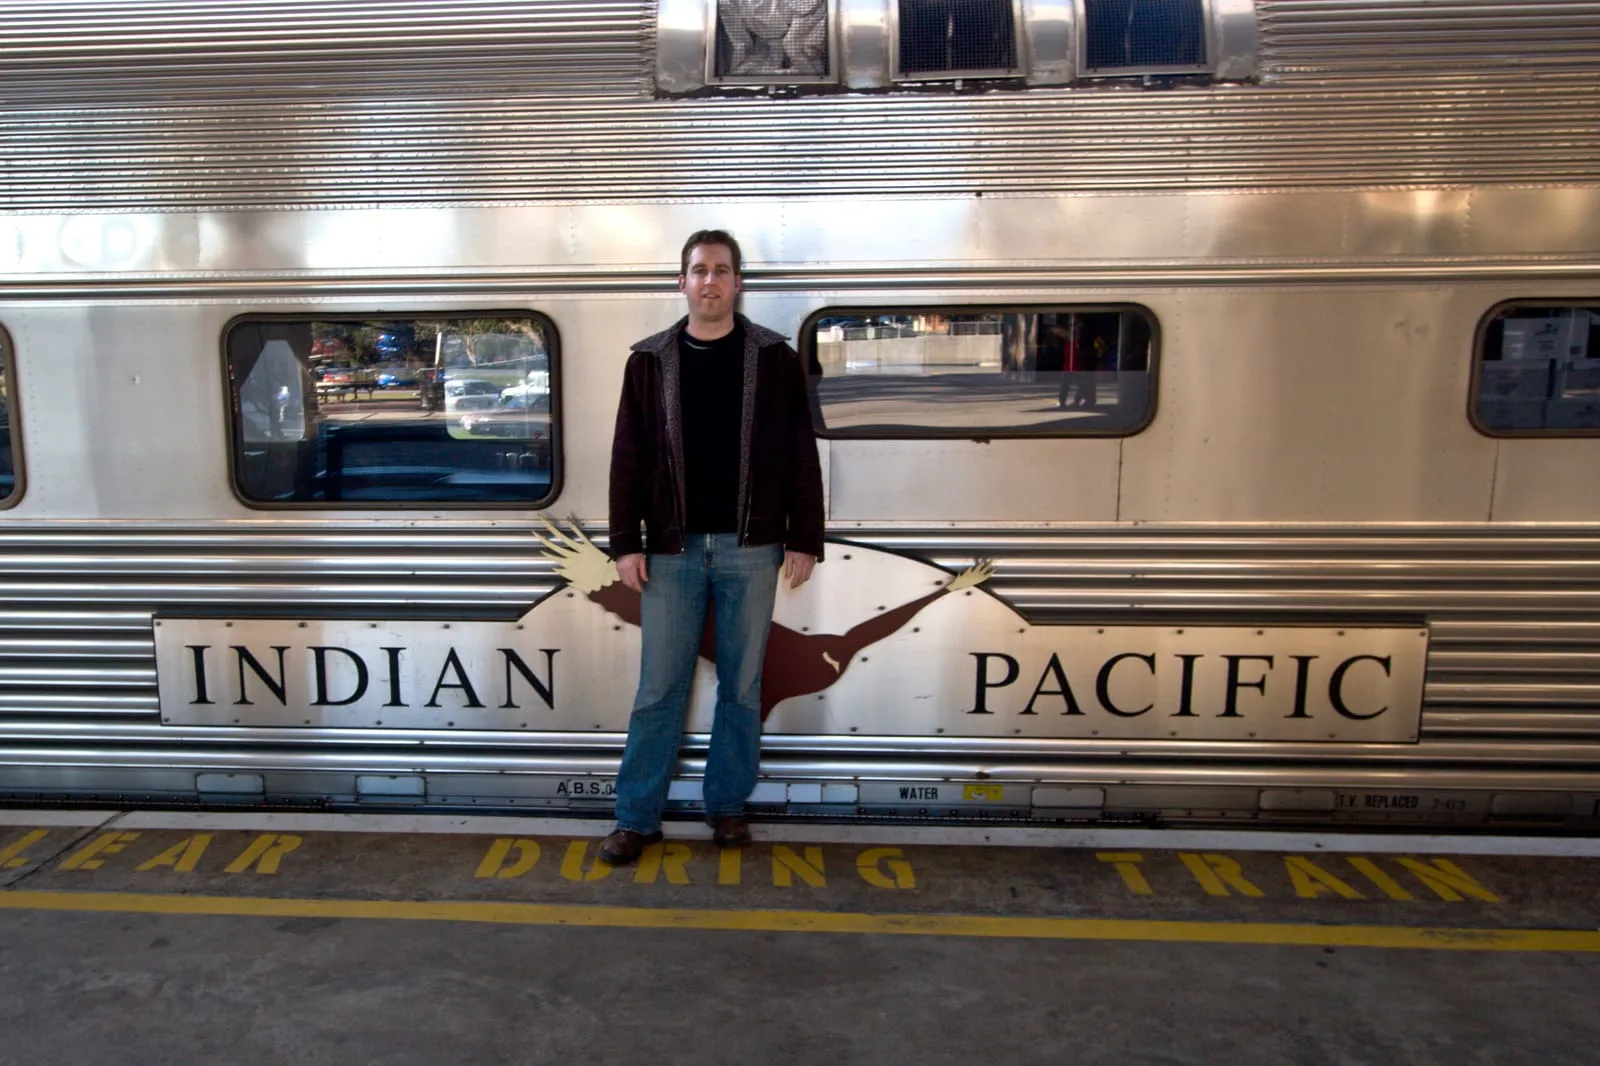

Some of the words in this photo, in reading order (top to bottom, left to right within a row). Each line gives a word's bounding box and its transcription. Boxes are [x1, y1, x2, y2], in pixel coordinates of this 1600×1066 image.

[184, 645, 561, 710] INDIAN
[966, 652, 1392, 720] PACIFIC
[899, 786, 938, 800] WATER
[1364, 793, 1419, 808] REPLACED
[473, 838, 917, 889] DURING
[1095, 851, 1502, 901] TRAIN
